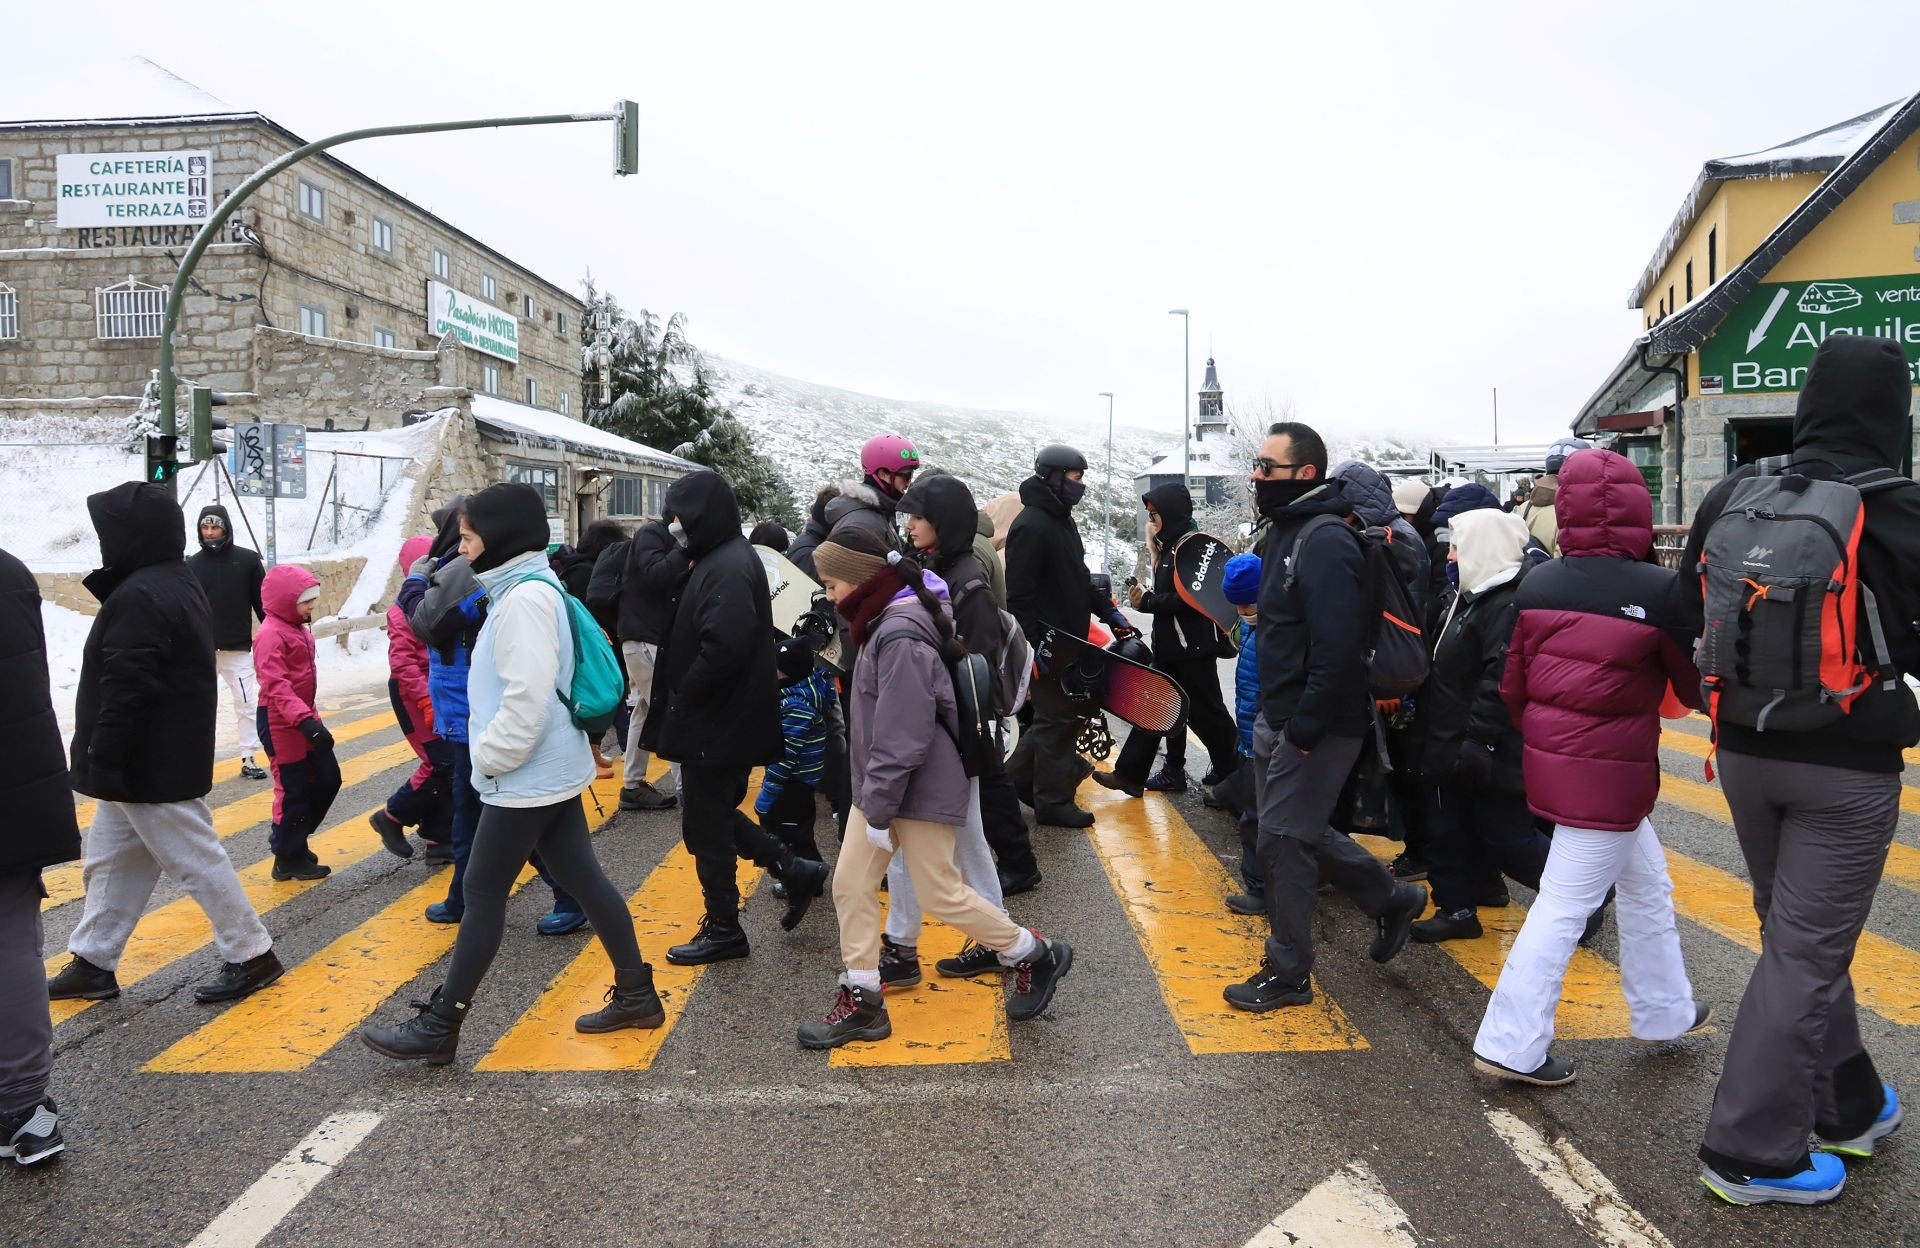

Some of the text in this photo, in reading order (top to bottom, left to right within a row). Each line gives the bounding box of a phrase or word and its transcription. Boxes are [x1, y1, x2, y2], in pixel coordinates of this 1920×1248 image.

[90, 156, 184, 175] CAFETERÍA
[62, 181, 185, 198] RESTAURANTE
[106, 202, 184, 217] TERRAZA
[1195, 541, 1217, 582] daktak
